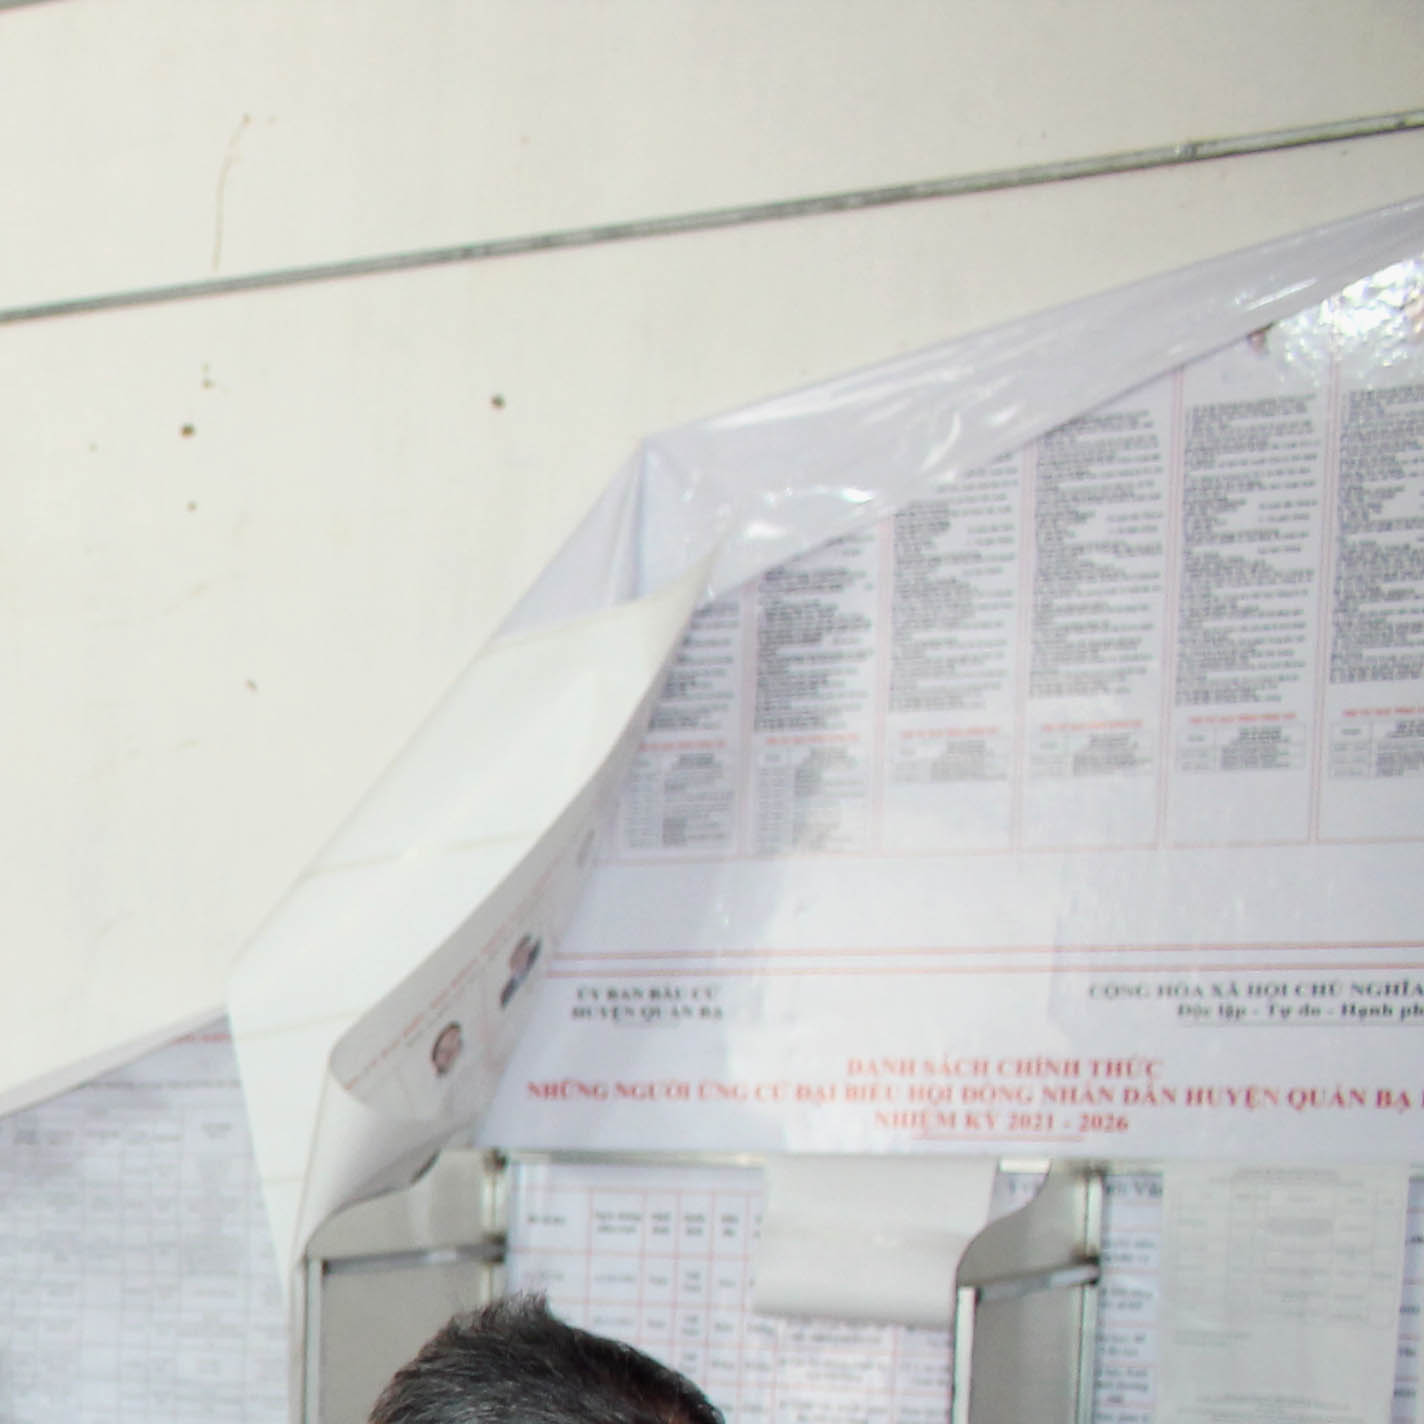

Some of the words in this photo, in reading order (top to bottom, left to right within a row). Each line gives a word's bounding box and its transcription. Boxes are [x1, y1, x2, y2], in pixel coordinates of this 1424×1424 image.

[847, 1057, 916, 1077] DANH
[1008, 1112, 1055, 1131] 2021
[1079, 1113, 1129, 1133] 2026
